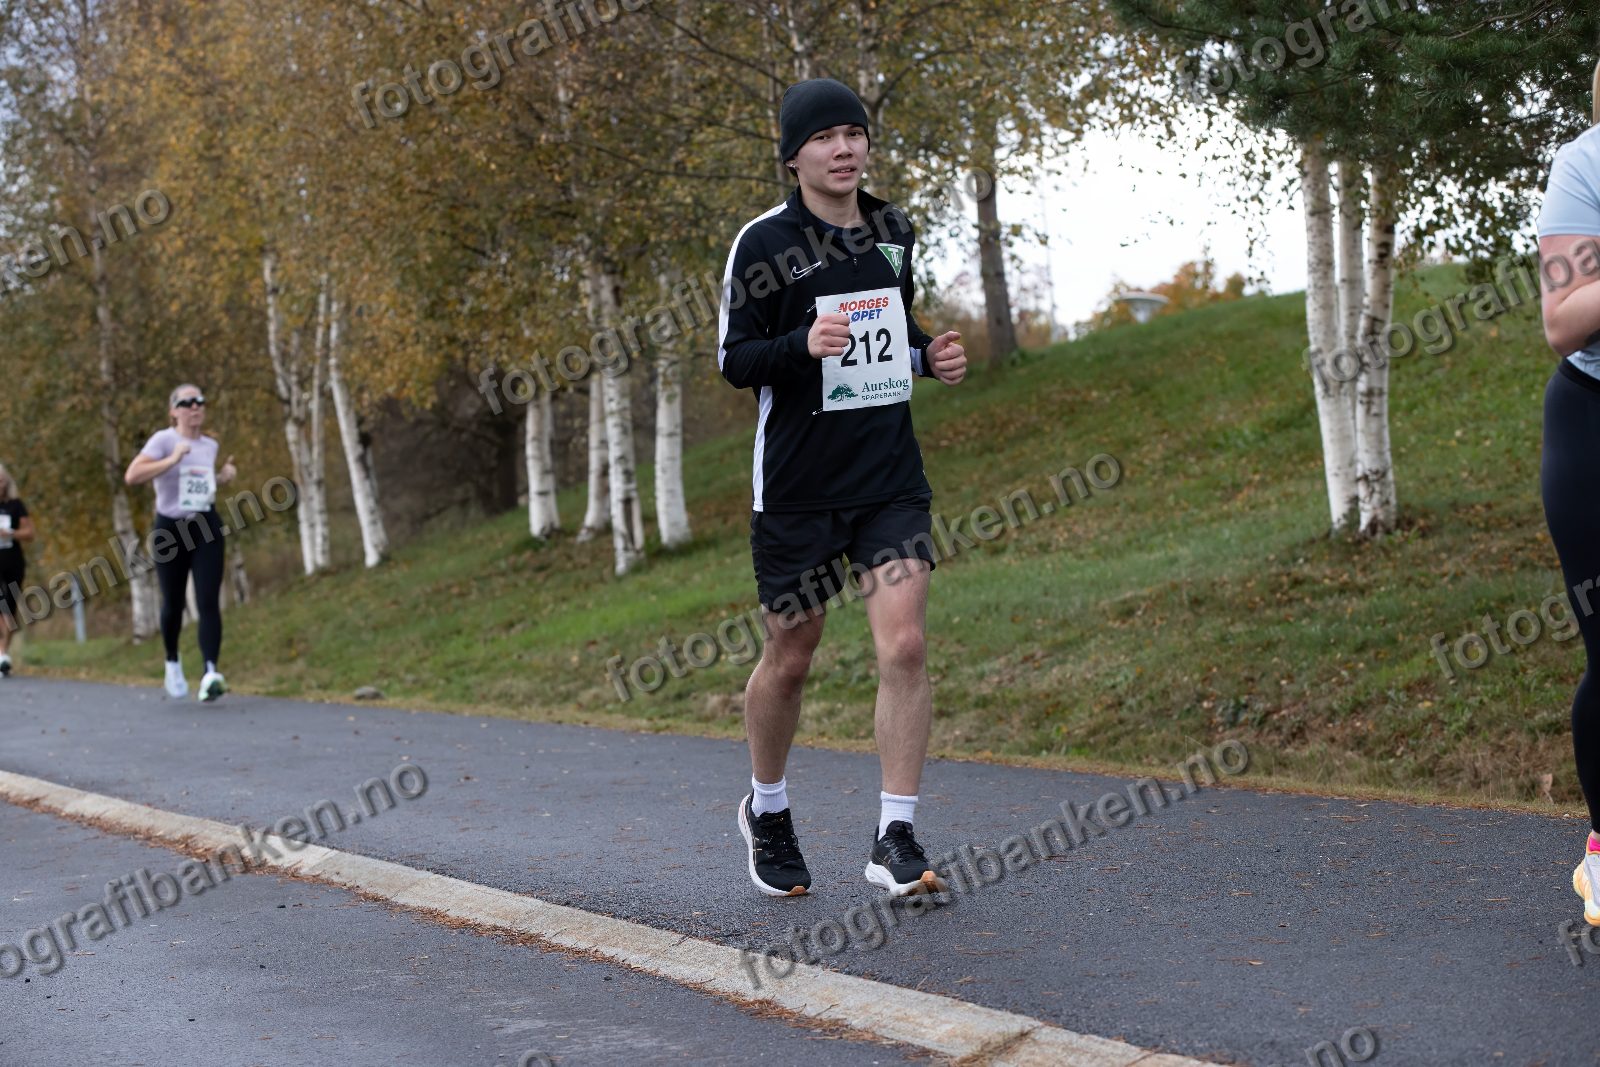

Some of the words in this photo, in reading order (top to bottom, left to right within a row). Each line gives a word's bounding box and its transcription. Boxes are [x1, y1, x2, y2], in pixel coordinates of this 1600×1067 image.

[838, 297, 889, 312] NORGES
[846, 308, 882, 323] ØPET
[841, 328, 893, 367] 212
[862, 378, 910, 392] Aurskog
[861, 391, 901, 401] SPAREBANK
